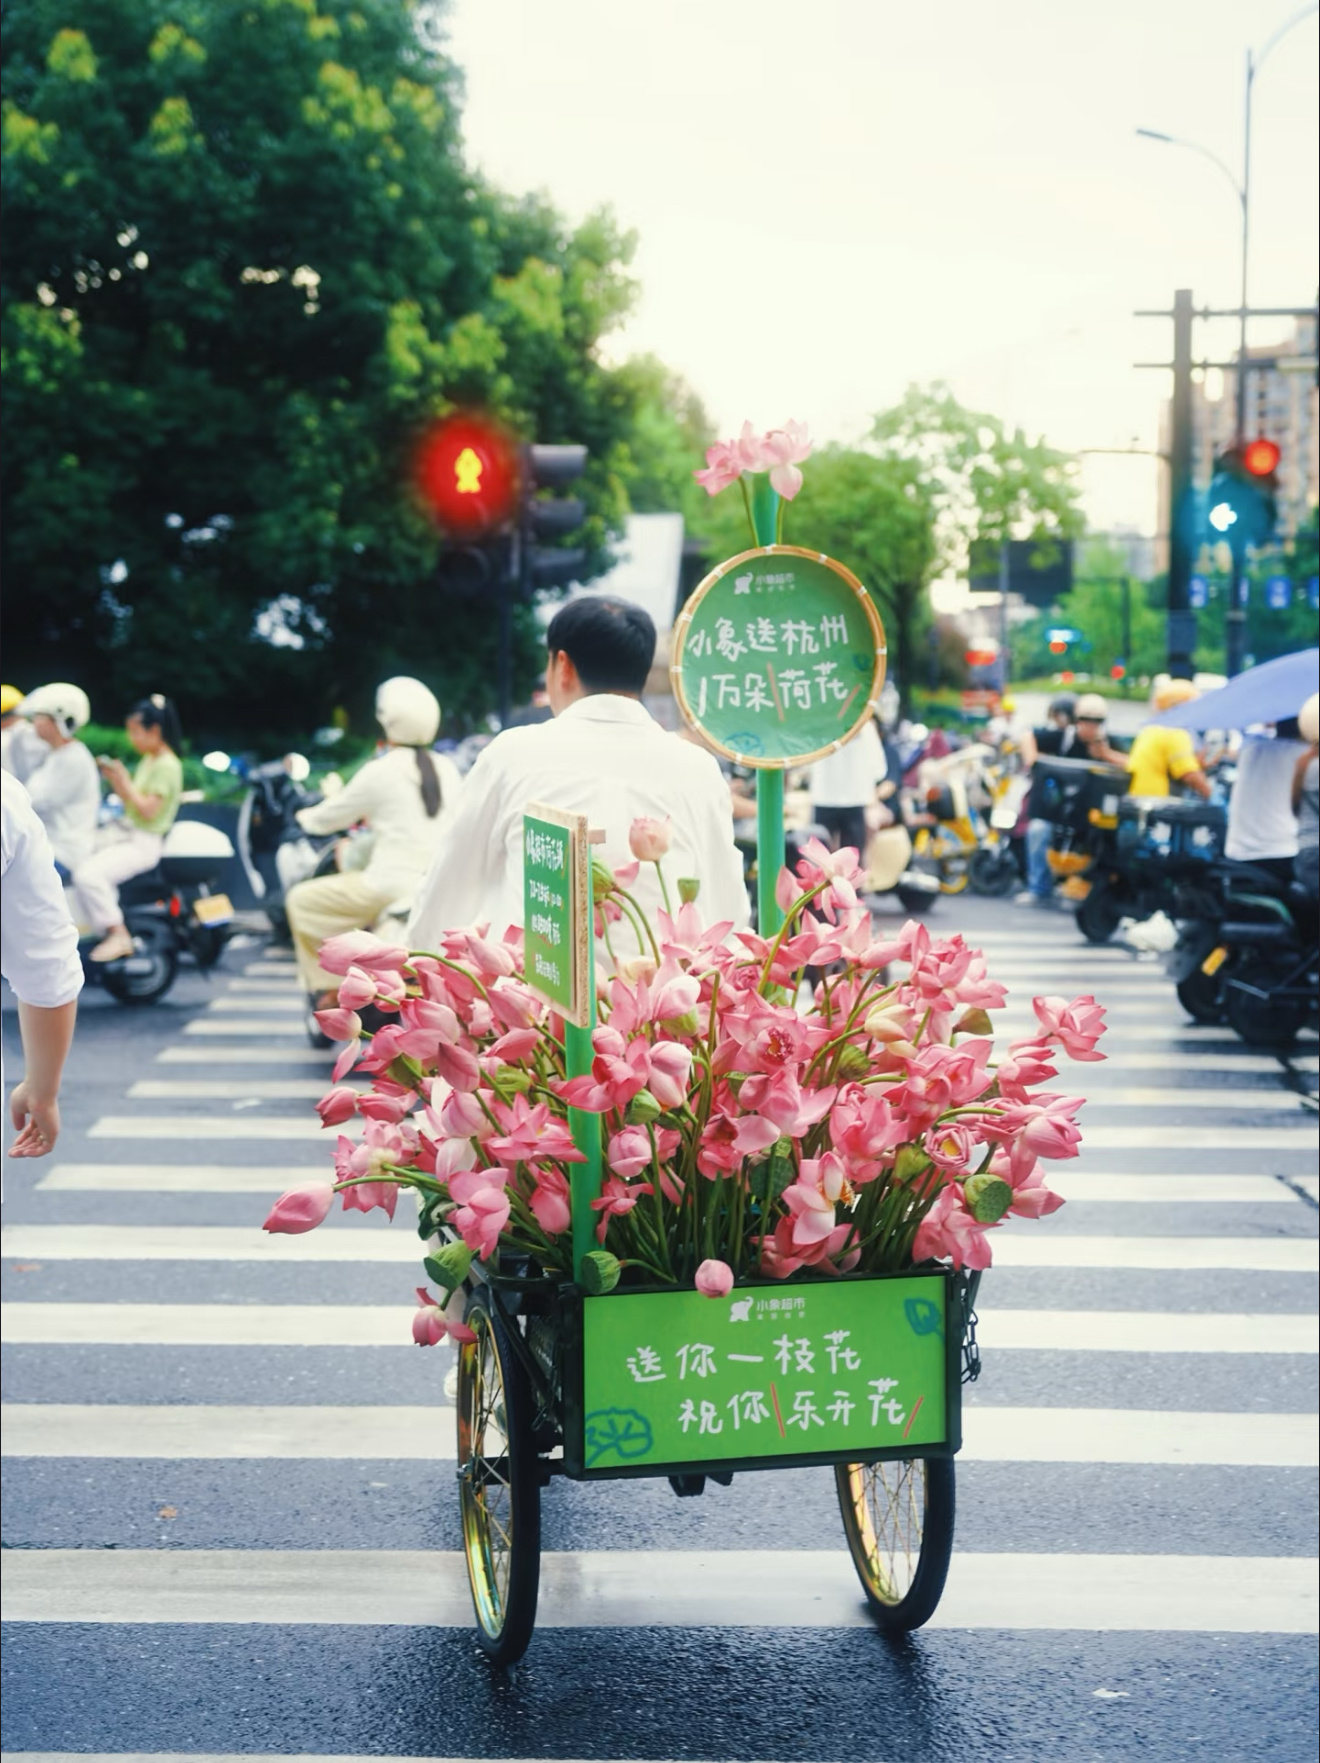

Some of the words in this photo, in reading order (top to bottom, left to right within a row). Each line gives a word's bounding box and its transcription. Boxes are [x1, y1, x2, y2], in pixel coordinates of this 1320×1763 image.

[688, 614, 849, 662] 小象送杭州
[697, 661, 849, 718] 1万朵荷花
[756, 1298, 807, 1312] 小象超市
[626, 1330, 861, 1382] 送你一枝花
